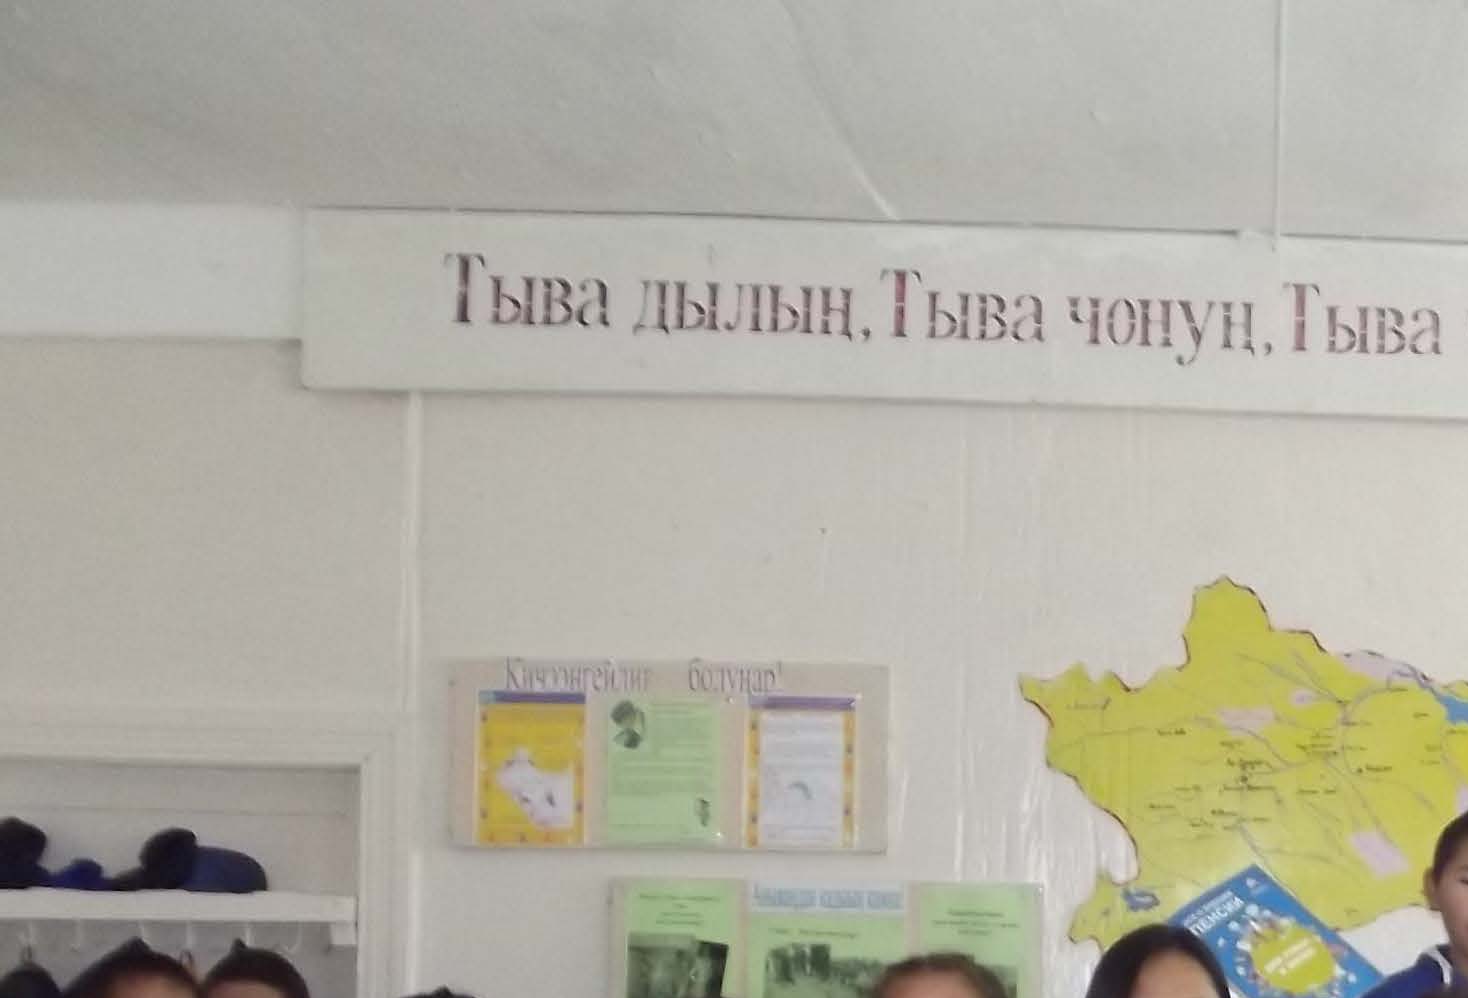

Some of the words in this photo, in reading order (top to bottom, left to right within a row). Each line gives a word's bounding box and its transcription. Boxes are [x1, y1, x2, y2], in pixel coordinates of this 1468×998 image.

[444, 253, 610, 328] Тыва
[880, 268, 1045, 343] Тыва
[1282, 282, 1442, 356] Тыва
